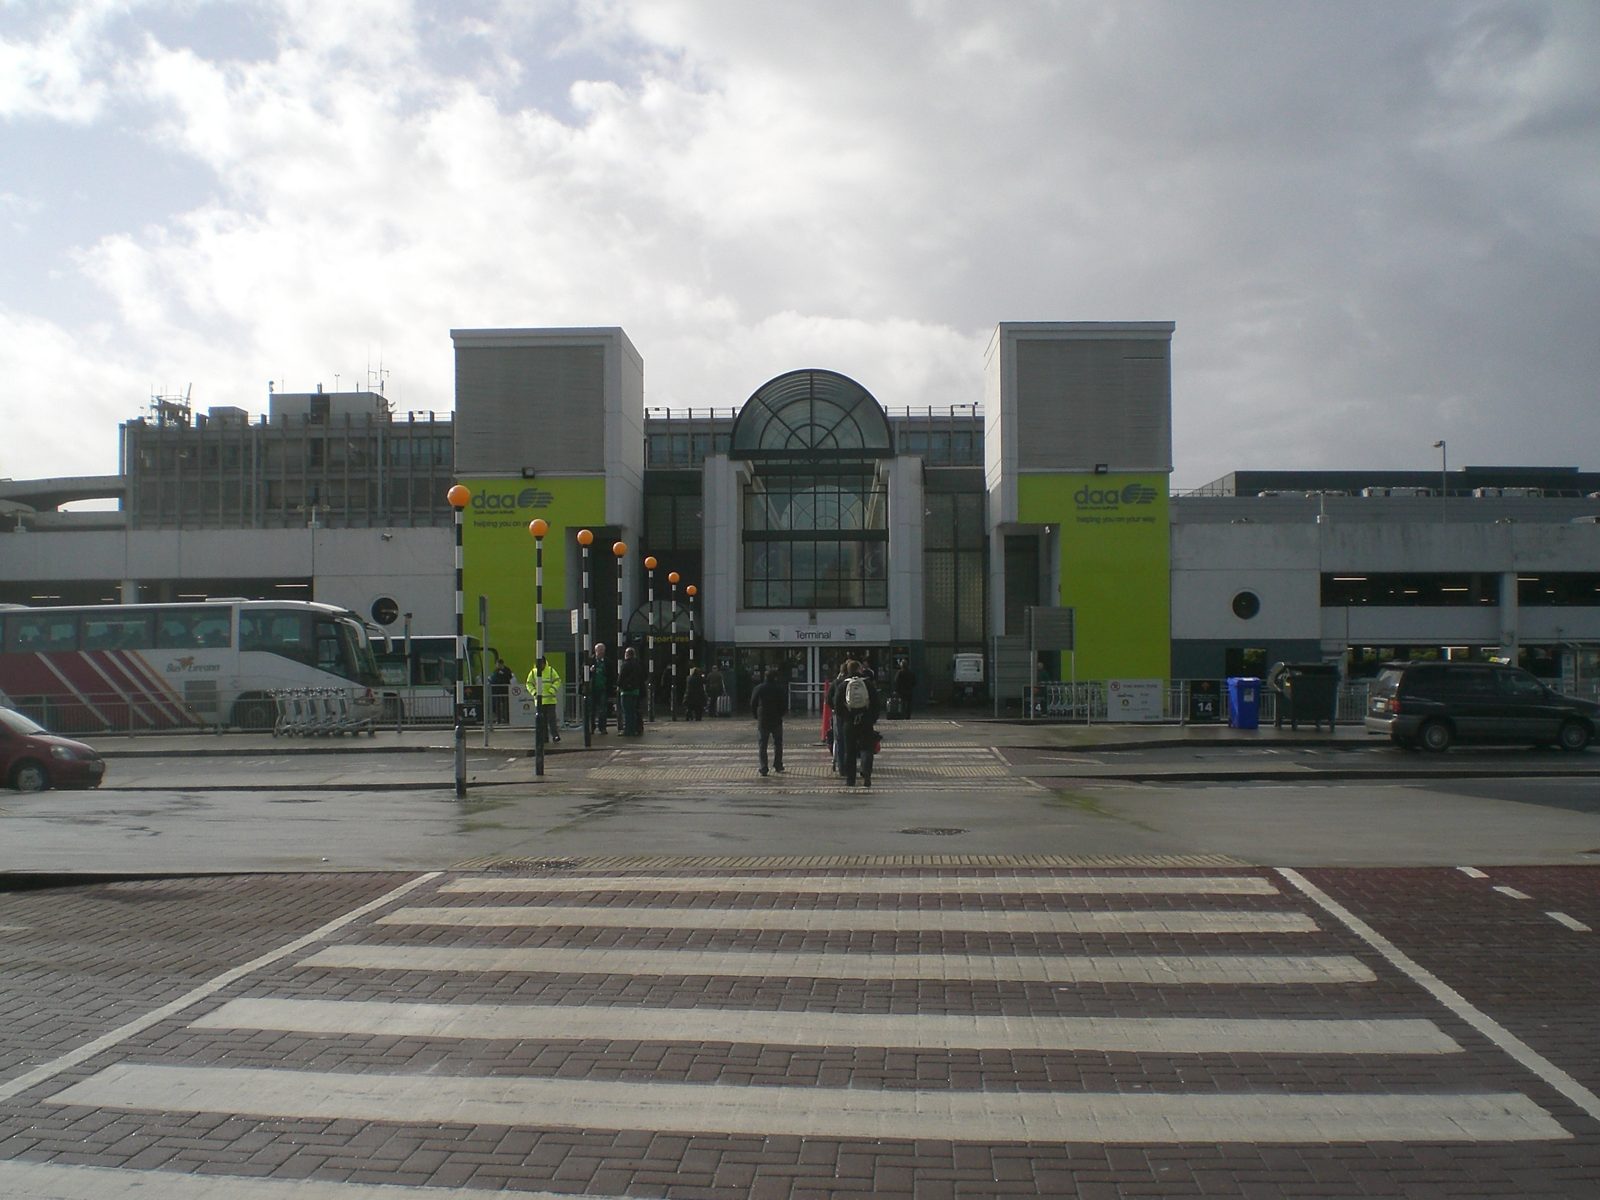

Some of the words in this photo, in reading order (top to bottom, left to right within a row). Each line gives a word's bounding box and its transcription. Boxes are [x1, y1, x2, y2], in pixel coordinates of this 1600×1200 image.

[471, 489, 515, 509] daa
[1073, 485, 1119, 504] daa
[473, 520, 498, 528] helping
[795, 630, 832, 640] Terminal
[1197, 702, 1212, 712] 14
[463, 707, 477, 718] 14
